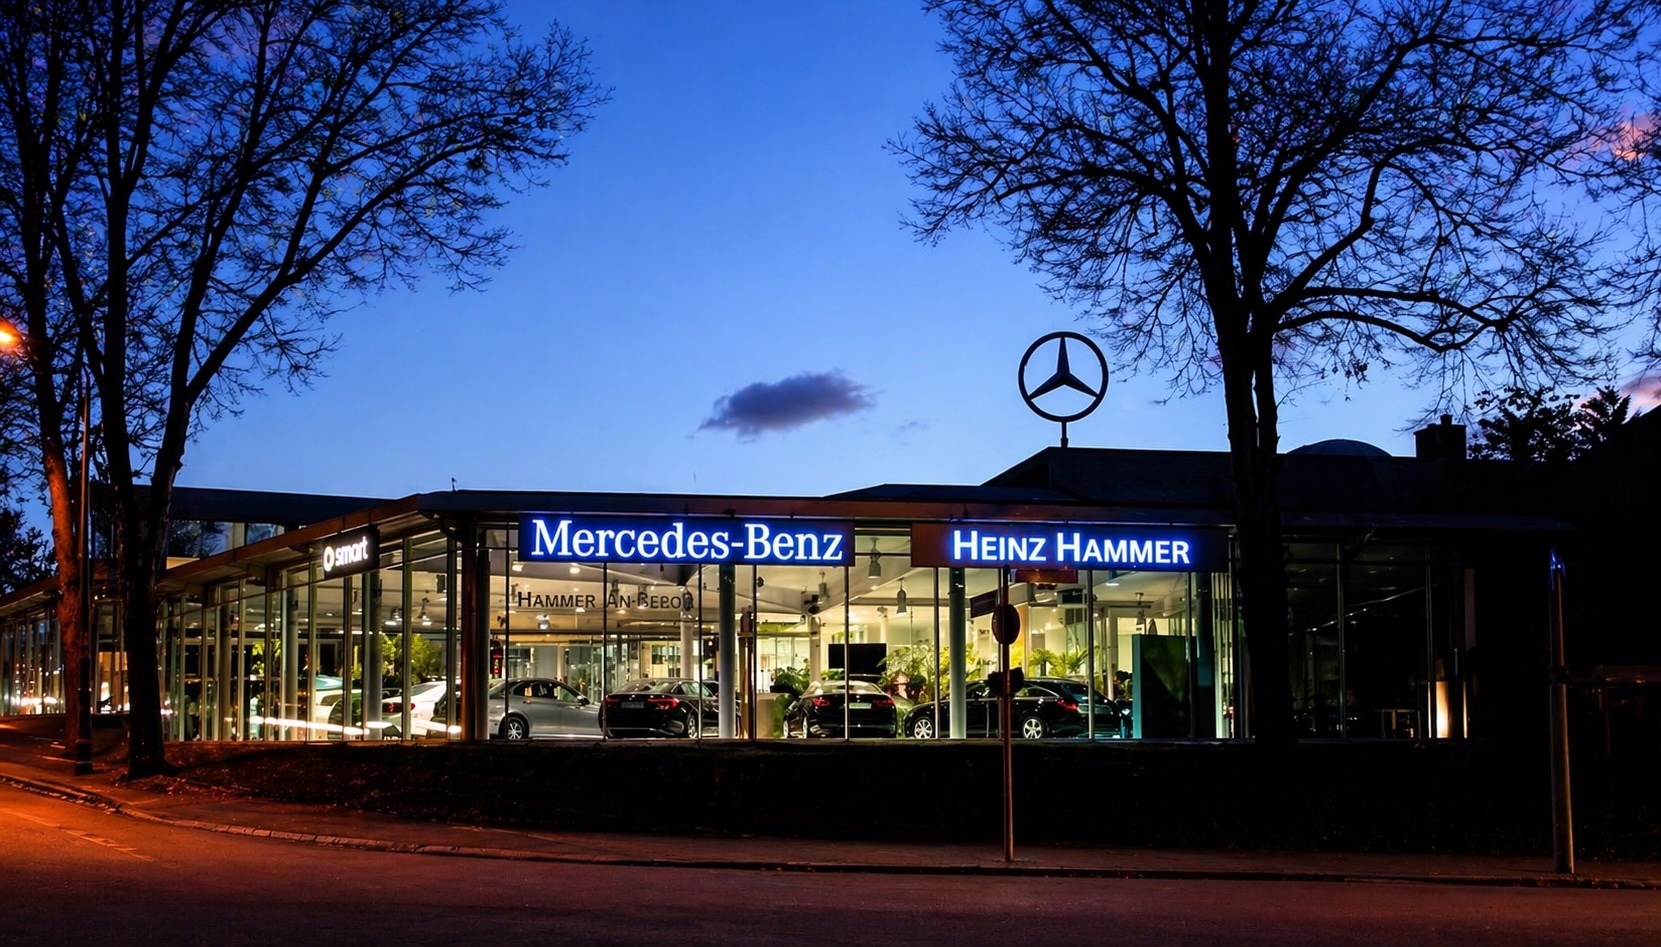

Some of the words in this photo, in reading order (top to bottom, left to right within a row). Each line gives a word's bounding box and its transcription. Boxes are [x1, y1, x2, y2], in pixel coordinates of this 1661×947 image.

[335, 536, 368, 566] smart
[531, 519, 843, 561] Mercedes-Benz
[953, 530, 1046, 562] HEINZ
[1056, 532, 1190, 564] HAMMER
